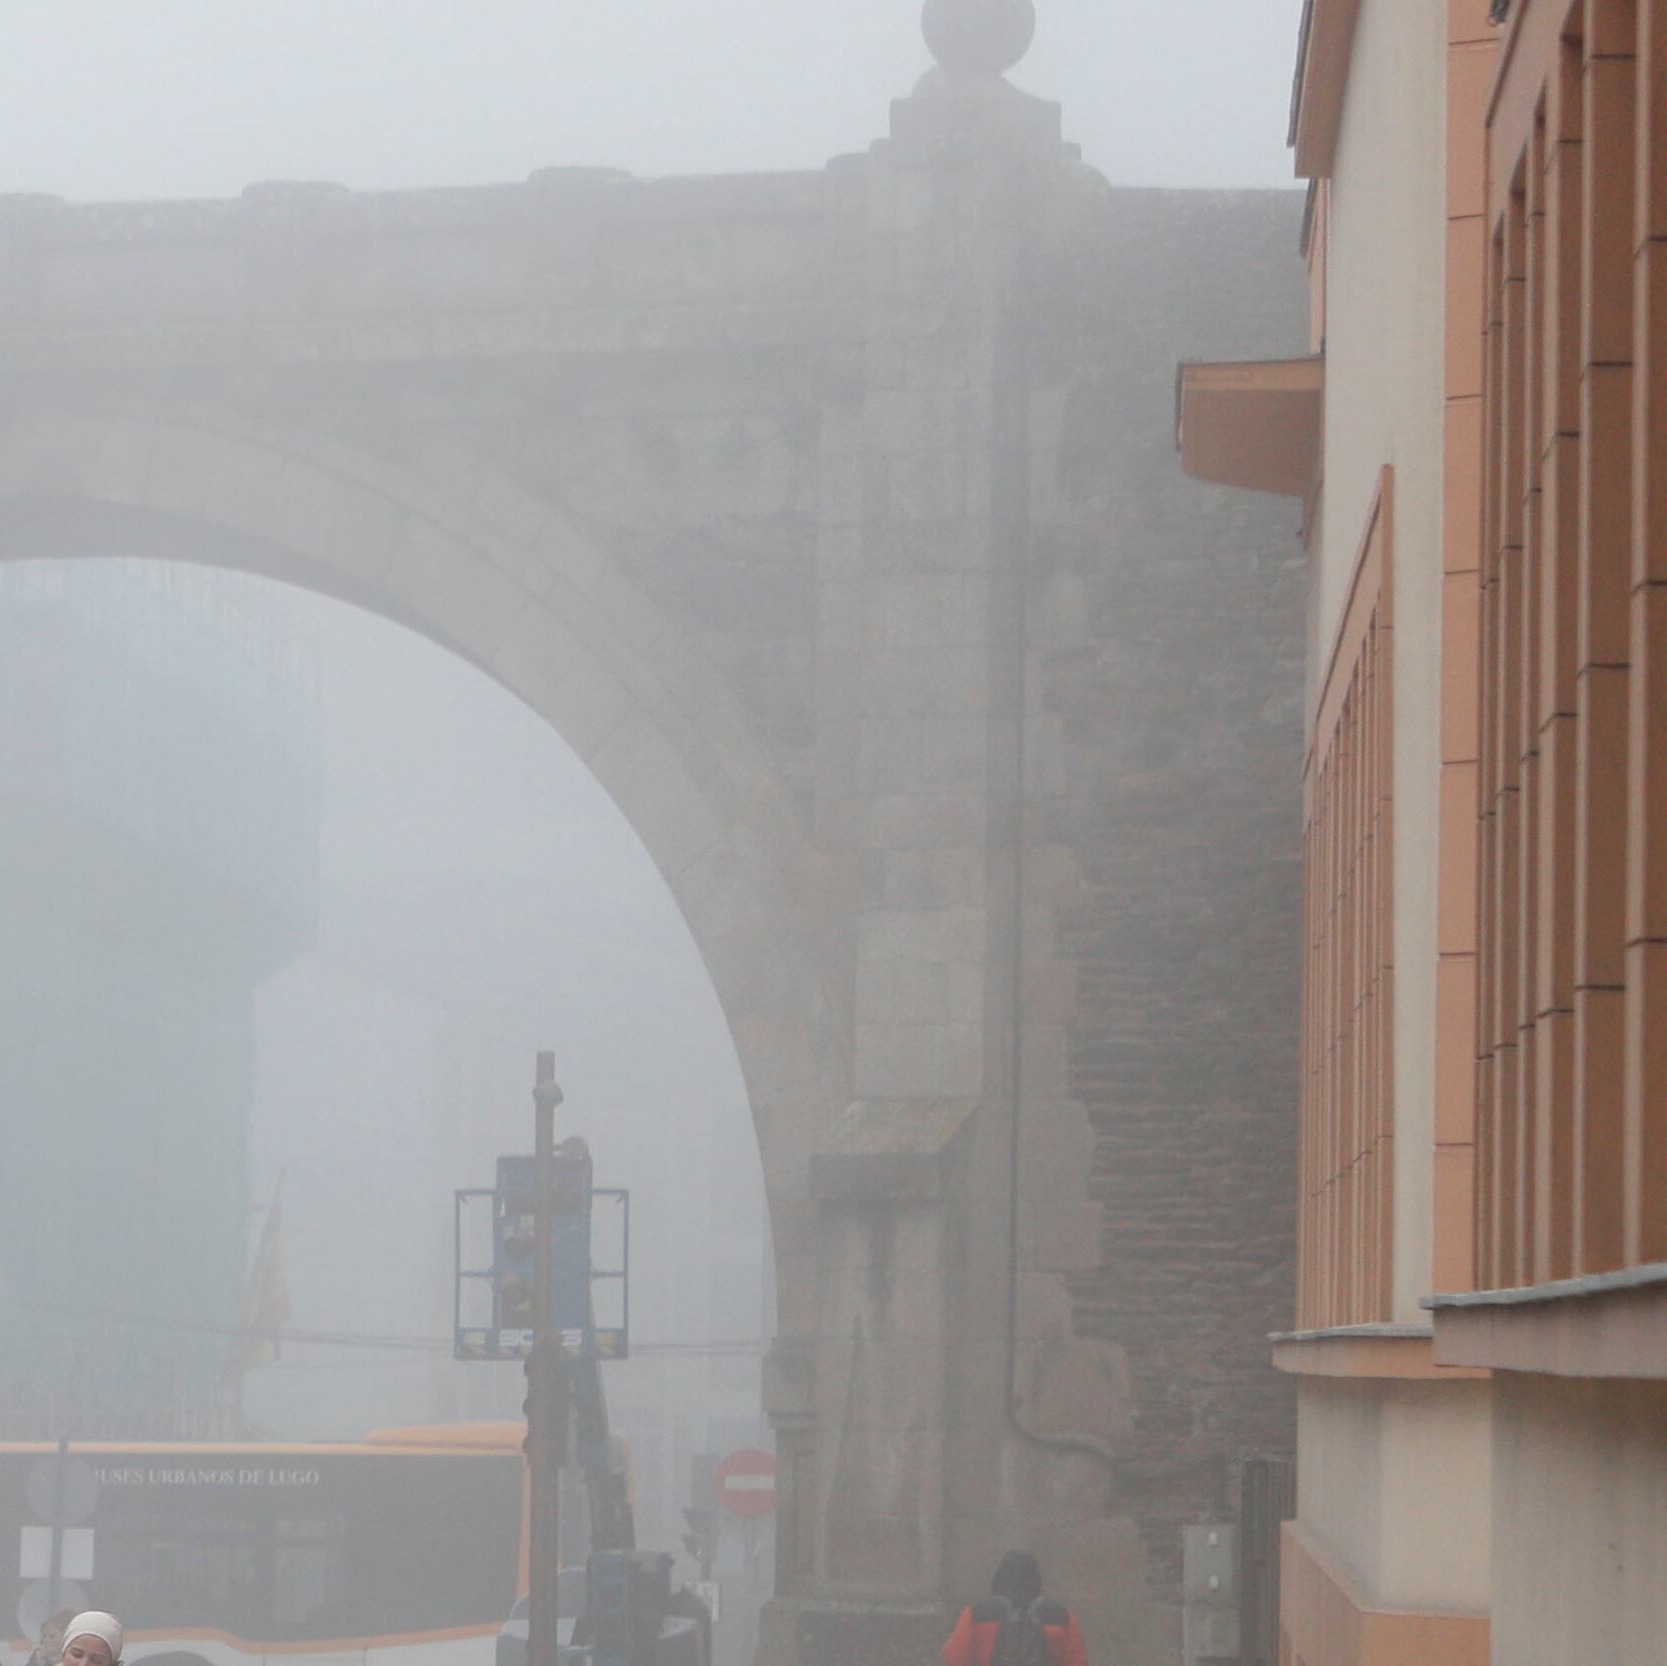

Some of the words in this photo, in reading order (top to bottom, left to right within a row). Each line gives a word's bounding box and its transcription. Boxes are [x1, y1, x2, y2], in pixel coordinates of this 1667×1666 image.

[148, 1467, 233, 1486] URBANOS
[239, 1468, 265, 1485] DE
[268, 1468, 321, 1486] LUGO
